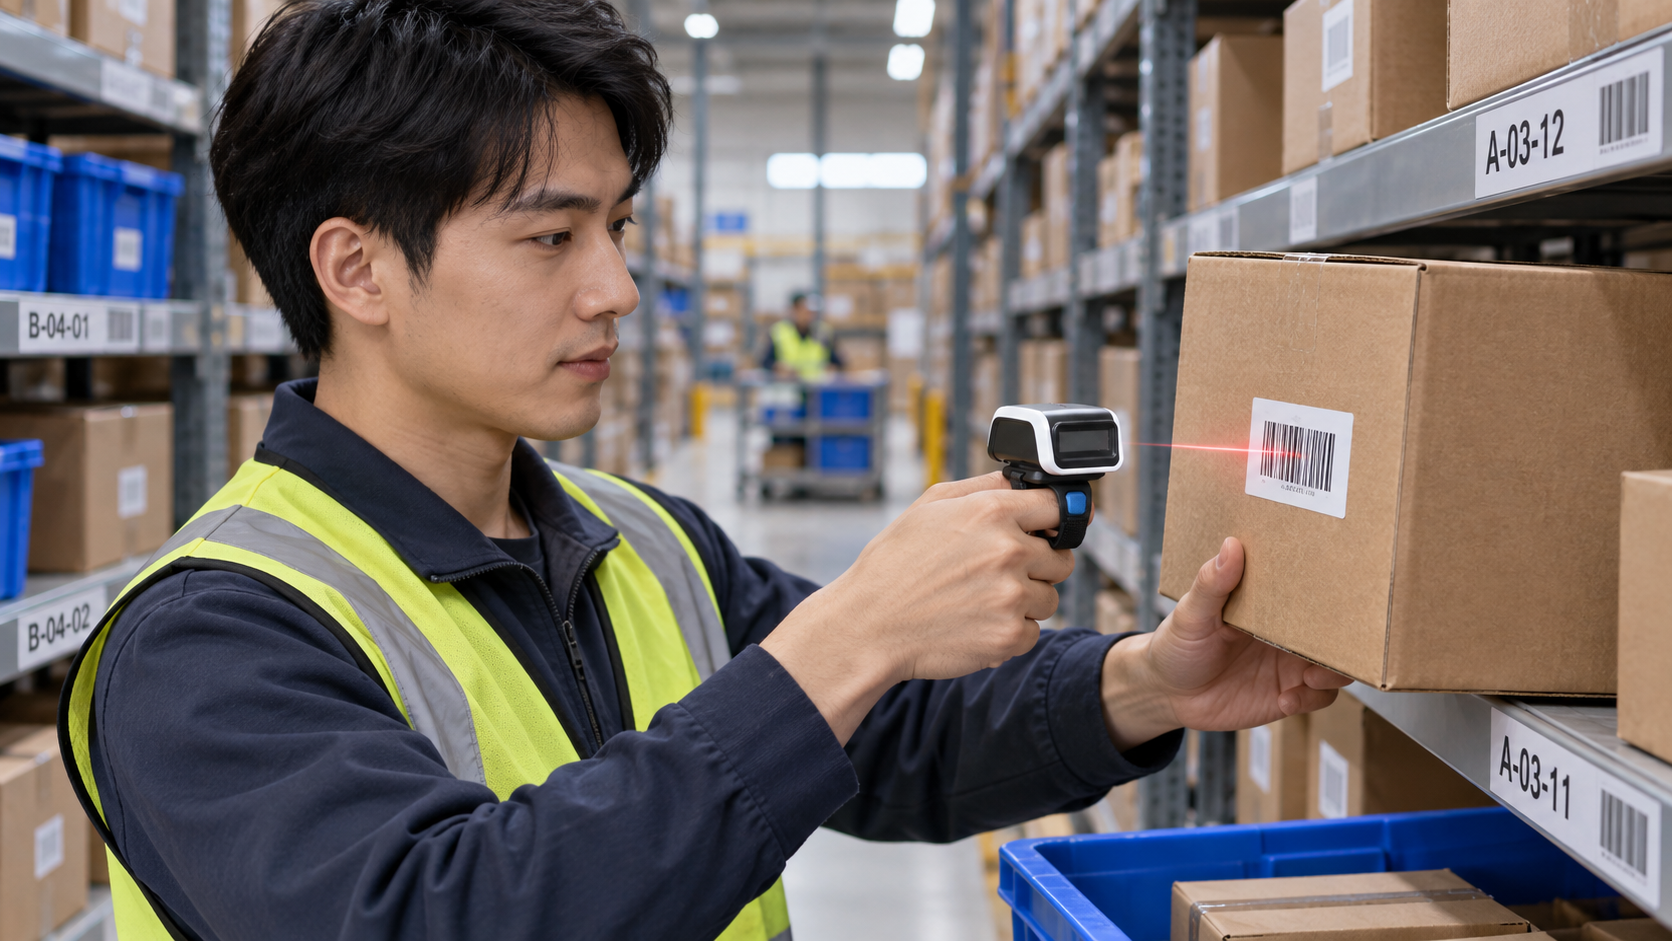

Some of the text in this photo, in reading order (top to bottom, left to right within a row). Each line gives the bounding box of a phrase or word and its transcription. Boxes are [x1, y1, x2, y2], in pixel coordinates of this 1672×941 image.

[1485, 109, 1564, 175] A-03-12
[29, 312, 89, 339] B-04-01
[29, 603, 90, 652] B-04-02
[1499, 735, 1570, 820] A-03-11
